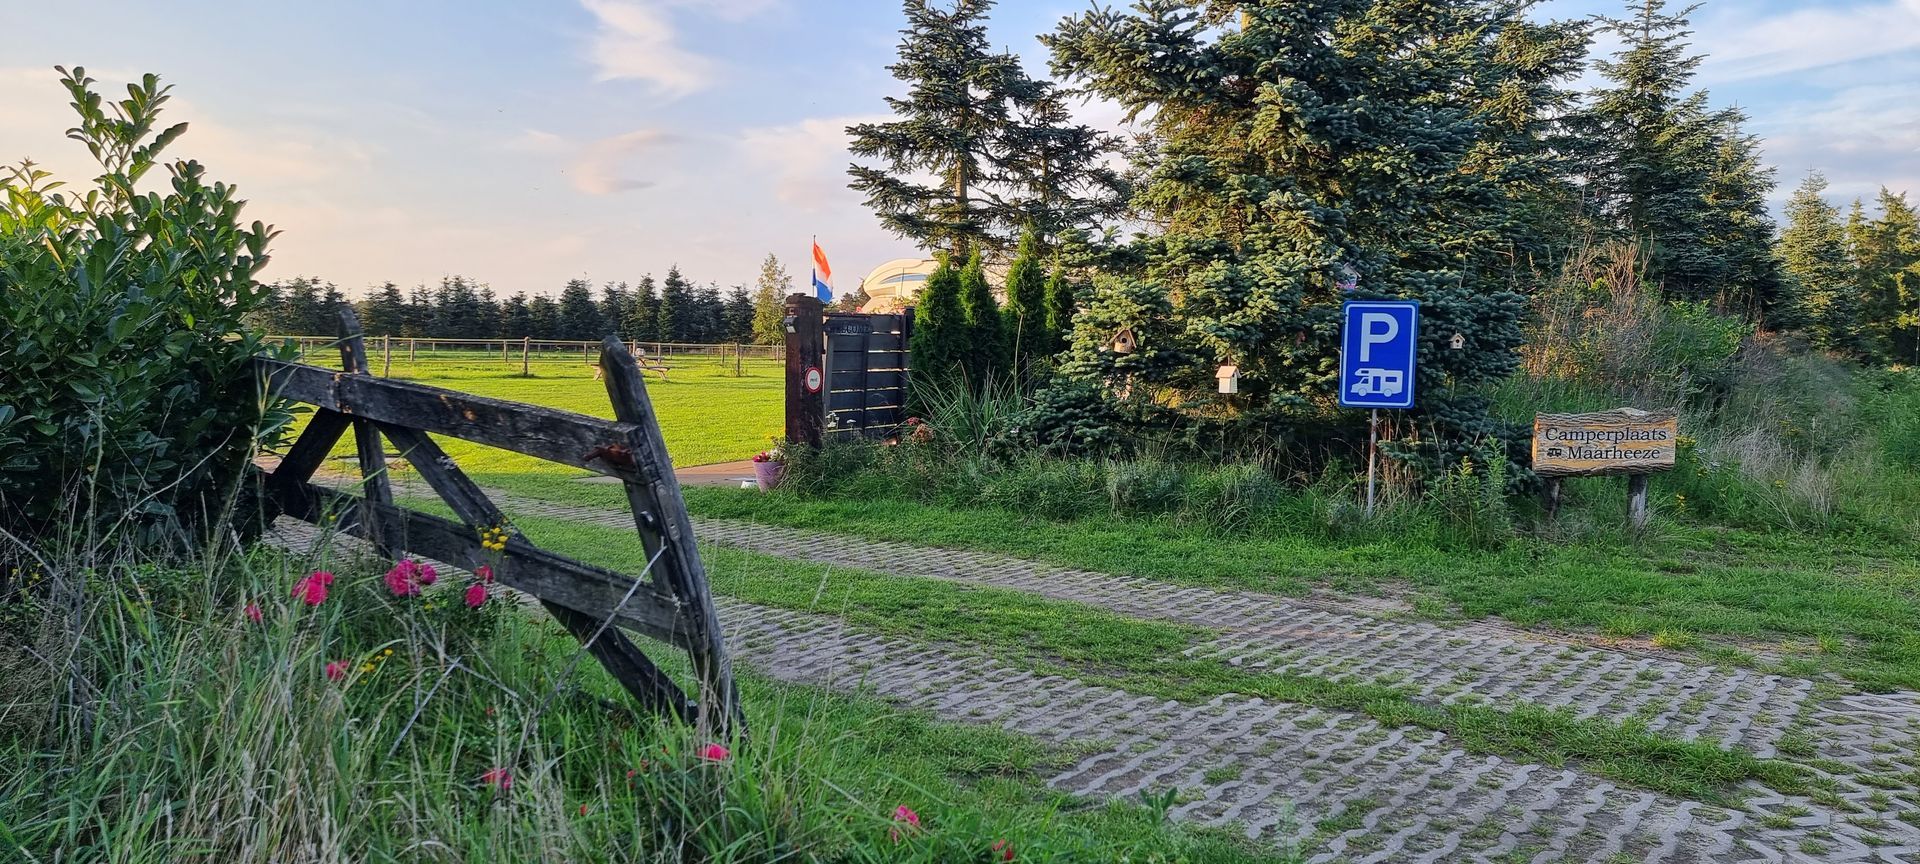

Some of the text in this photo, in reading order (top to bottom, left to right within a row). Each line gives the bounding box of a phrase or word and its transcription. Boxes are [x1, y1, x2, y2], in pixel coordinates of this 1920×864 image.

[1360, 313, 1398, 362] P
[1545, 427, 1667, 444] Camperplaats
[1567, 446, 1660, 460] Maarheeze
